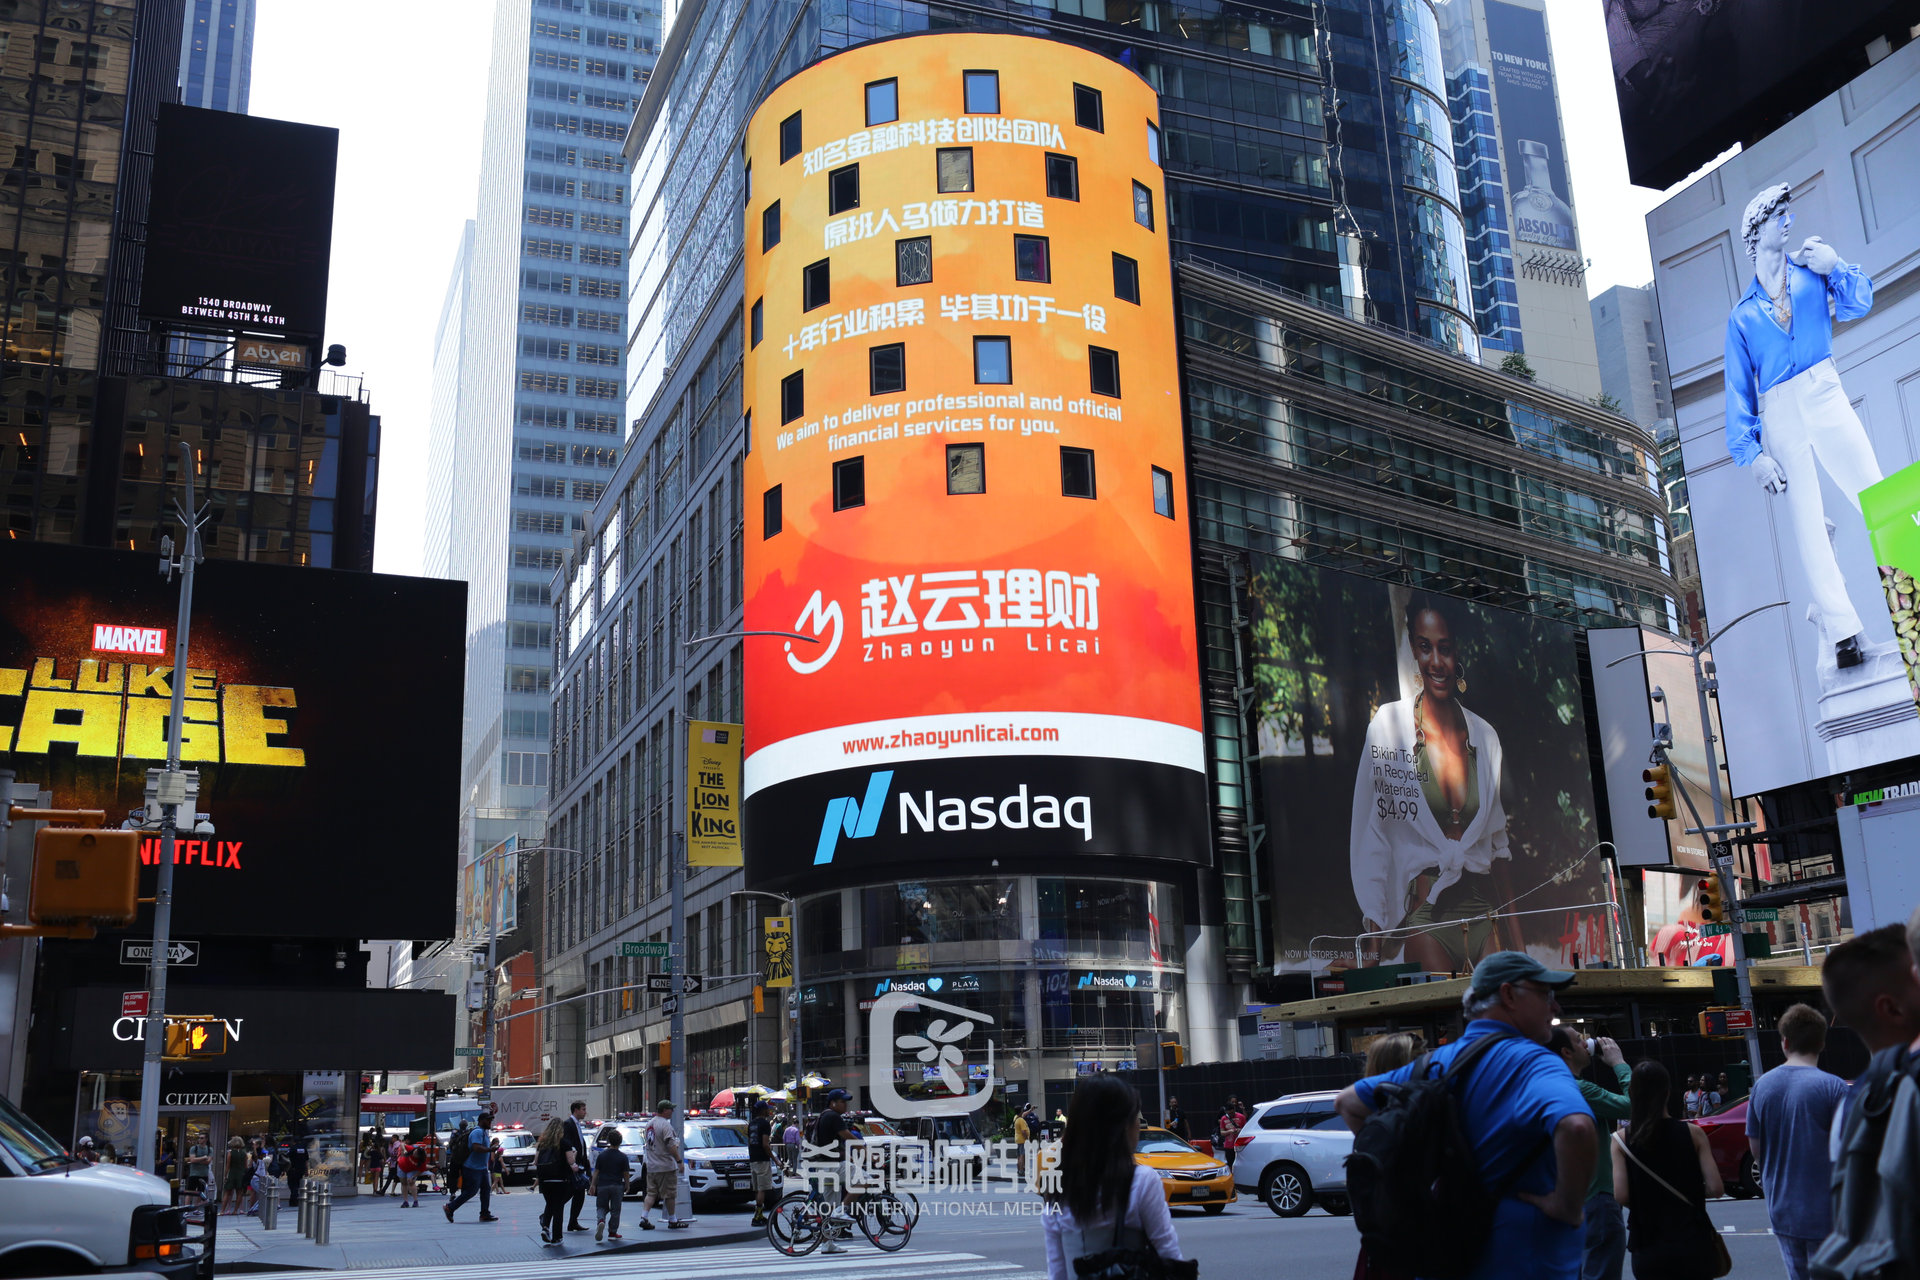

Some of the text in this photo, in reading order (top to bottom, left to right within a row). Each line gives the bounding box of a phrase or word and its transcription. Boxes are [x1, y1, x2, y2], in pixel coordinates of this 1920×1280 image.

[1491, 50, 1503, 61] TO
[1504, 54, 1523, 66] NEW
[803, 117, 1067, 178] 知名金融科技创始团队
[824, 199, 1044, 251] 原班人马倾力打造
[182, 305, 285, 325] BETWEEN 45TH & 46TH
[199, 297, 271, 313] 1540 BROADWAY
[782, 293, 1107, 361] 十年行业积累 毕其功于一役
[243, 345, 301, 364] Absen
[776, 391, 1122, 452] We aim to deliver professional and official
[827, 414, 1060, 453] financial services for you.
[861, 568, 1100, 639] 赵云理财
[94, 626, 164, 654] MARVEL
[863, 633, 1100, 662] Zhaoyun Licai
[30, 657, 217, 699] LUKE
[0, 667, 306, 766] AGE
[842, 724, 1059, 755] www.zhaoyunlicai.com
[1371, 745, 1419, 767] Bikini Top
[698, 771, 724, 786] THE
[1373, 762, 1429, 784] in Recycled
[694, 787, 729, 810] LION
[1374, 780, 1420, 799] Materials
[899, 784, 1092, 841] Nasdaq
[1377, 796, 1418, 821] $4.99
[691, 810, 735, 838] KING
[1721, 856, 1732, 864] LANE
[1747, 911, 1777, 920] Broadway
[1558, 911, 1606, 967] H&M
[133, 947, 153, 957] ONE
[624, 944, 667, 957] Broadway
[1285, 949, 1300, 959] NOW
[1311, 951, 1339, 960] STORES
[1339, 951, 1354, 960] AND
[1358, 951, 1380, 961] NLINE
[655, 980, 671, 988] ONE
[890, 980, 980, 993] Nasdaq PLAYA
[1093, 976, 1124, 988] Nasdaq
[456, 1048, 482, 1056] BROADWAY
[165, 1092, 230, 1105] CITIZEN
